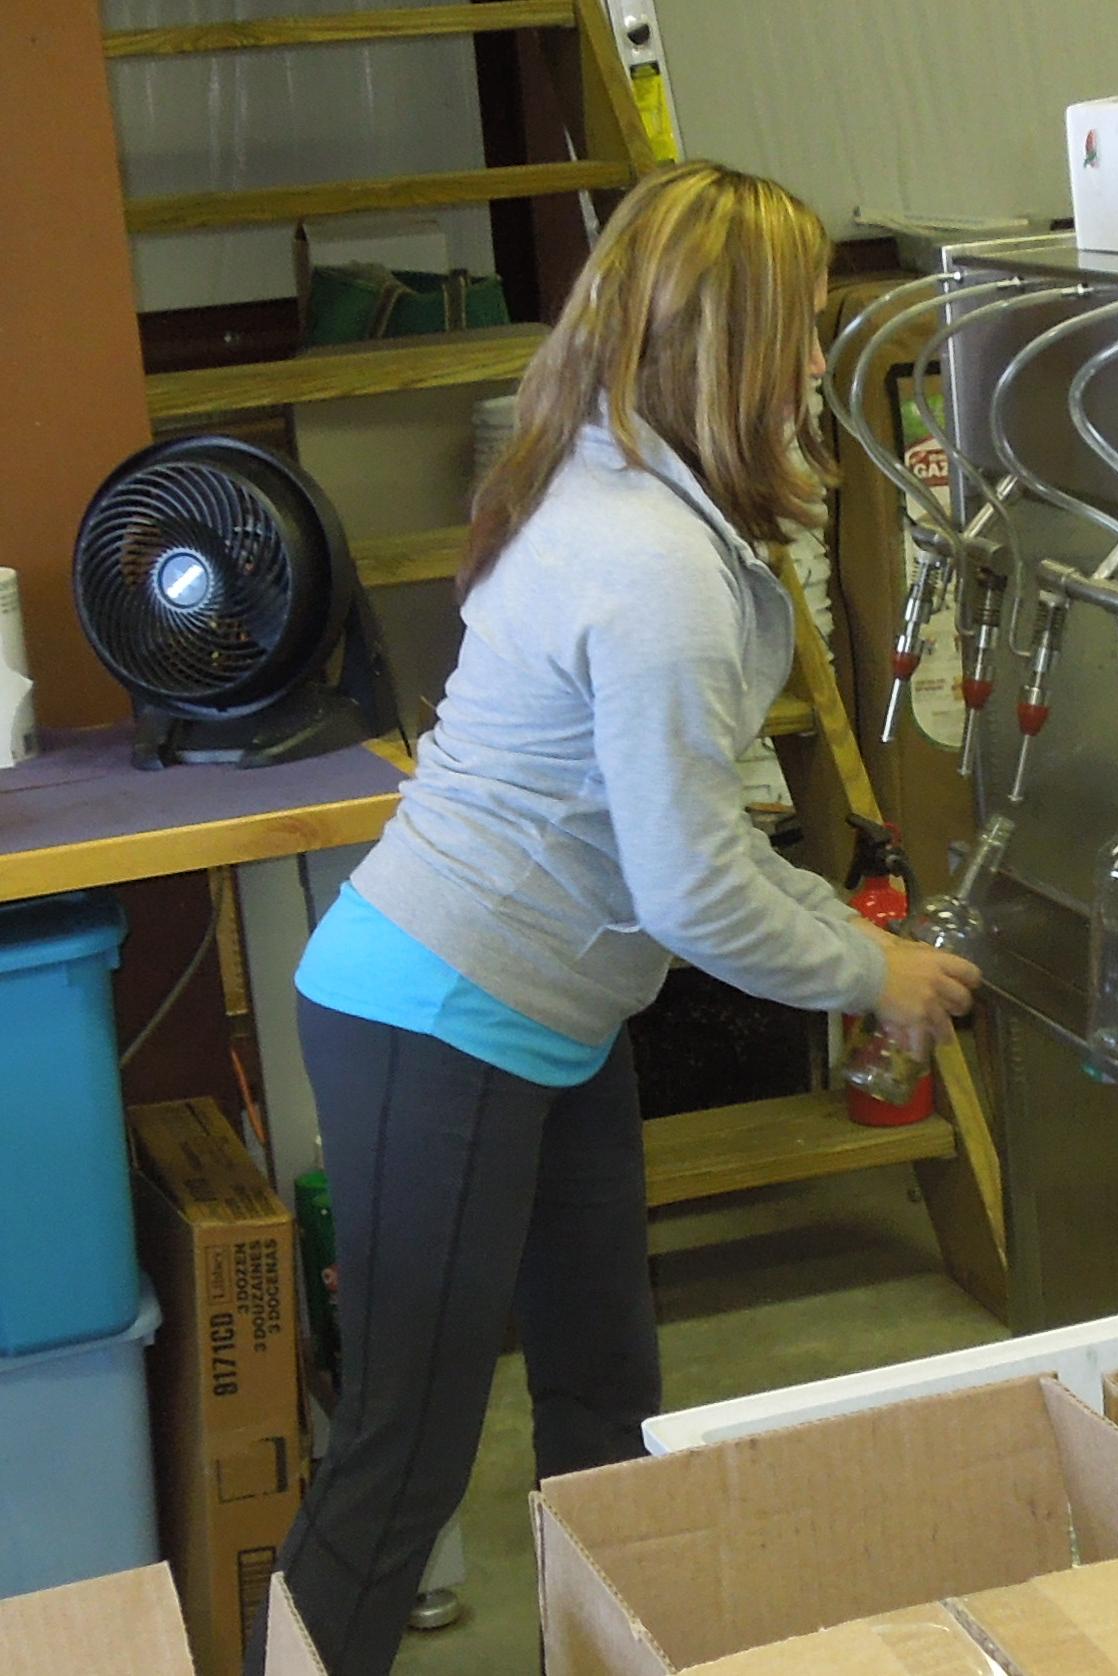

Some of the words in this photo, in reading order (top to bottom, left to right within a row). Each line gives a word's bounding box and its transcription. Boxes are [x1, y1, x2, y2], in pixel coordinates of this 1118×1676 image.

[234, 1242, 248, 1301] DOZEN
[249, 1240, 266, 1339] DOUZAINES
[264, 1238, 280, 1321] DOCENAS
[238, 1304, 249, 1314] 3
